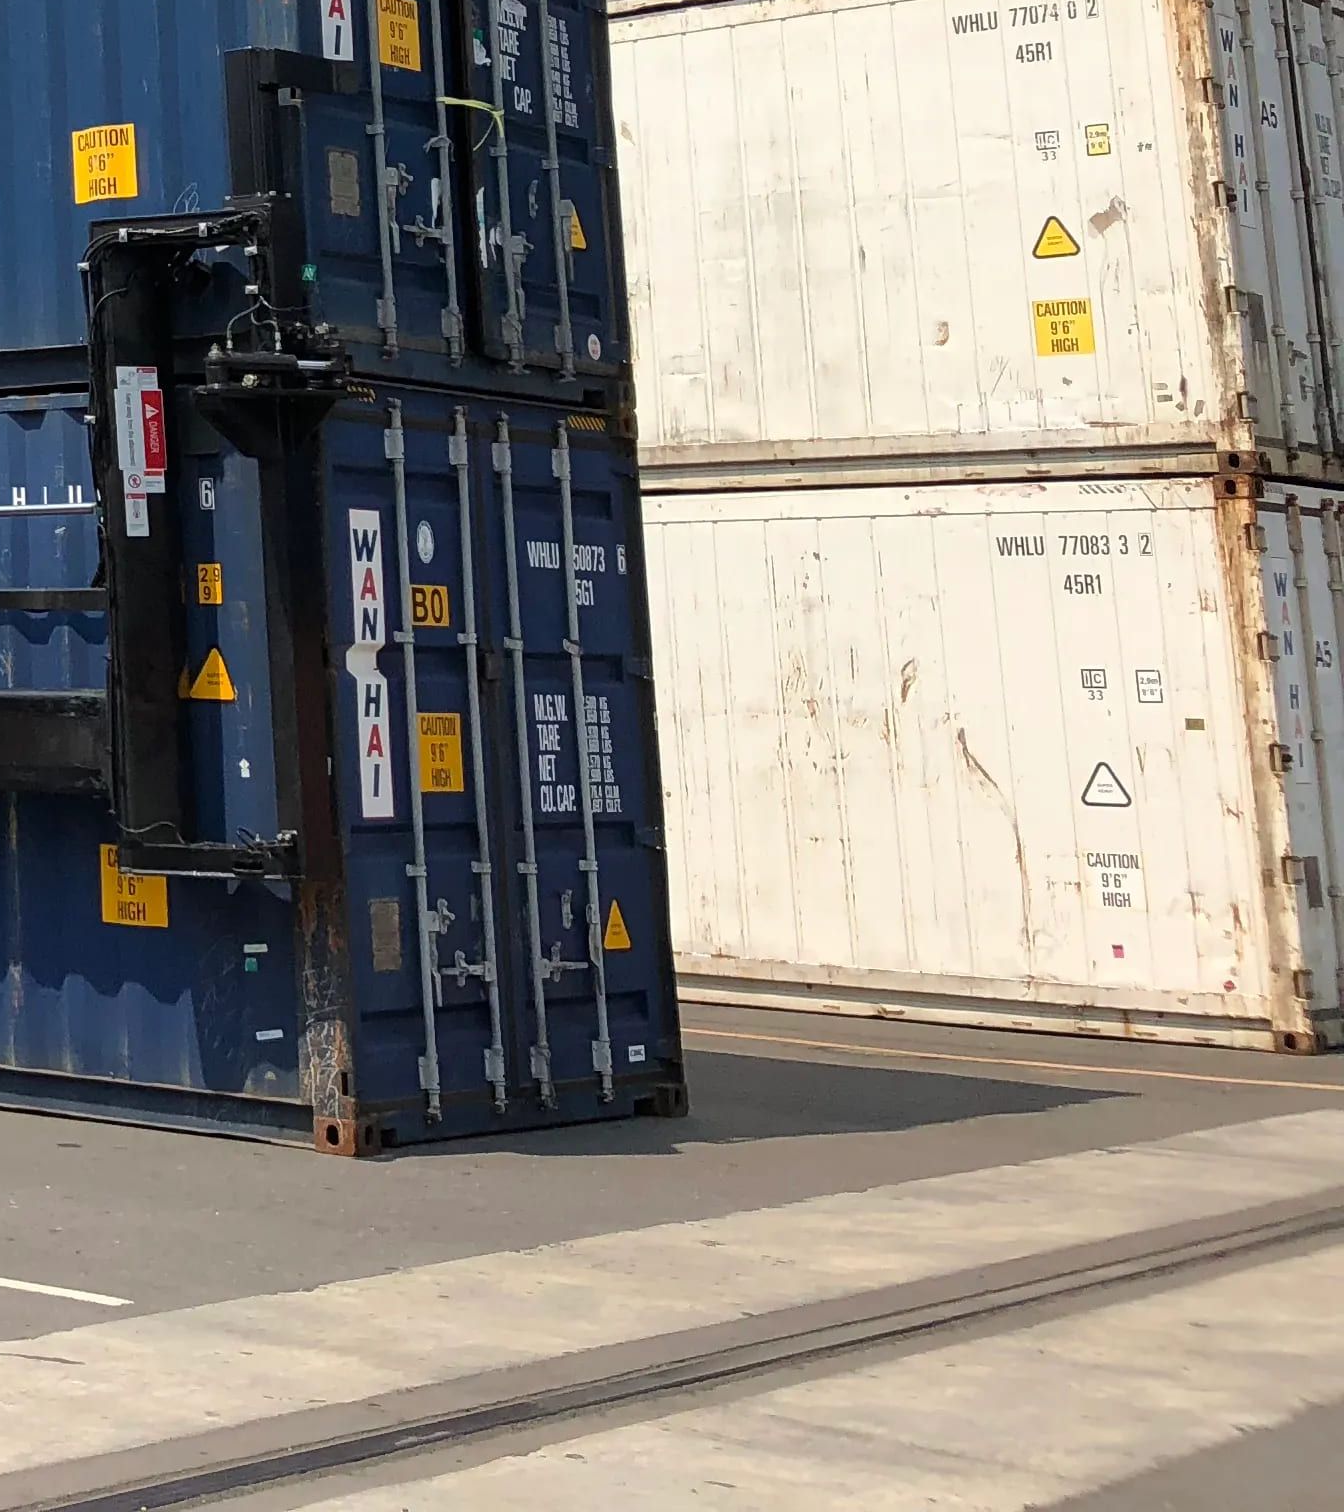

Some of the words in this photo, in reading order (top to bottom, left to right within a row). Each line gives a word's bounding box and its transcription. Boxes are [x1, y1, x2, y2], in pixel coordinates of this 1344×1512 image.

[952, 11, 999, 36] WHLU
[1009, 2, 1060, 27] 77074
[389, 41, 411, 66] HIGH
[498, 26, 521, 57] TARE
[1015, 41, 1053, 64] 45R1
[1219, 27, 1239, 108] WAN
[1234, 133, 1249, 213] HAI
[1260, 101, 1278, 129] A5
[77, 127, 130, 153] CAUTION
[1041, 151, 1057, 162] 33
[88, 177, 118, 198] HIGH
[1036, 300, 1087, 318] CAUTION
[1050, 319, 1076, 336] 9'6"
[1050, 337, 1079, 353] HIGH
[148, 421, 160, 454] DANGER
[202, 480, 213, 507] 6
[526, 540, 560, 571] WHLU
[616, 547, 626, 571] 6
[996, 535, 1045, 557] WHLU
[1057, 534, 1110, 556] 77083
[1118, 535, 1129, 555] 3
[1140, 534, 1150, 555] 2
[351, 527, 379, 642] WAN
[1063, 574, 1103, 595] 45R1
[1273, 571, 1294, 656] WAN
[1288, 684, 1304, 768] HAI
[534, 693, 568, 722] M.G.W.
[1087, 690, 1104, 701] 33
[420, 715, 456, 737] CAUTION
[536, 724, 561, 751] TARE
[363, 683, 384, 798] HAI
[431, 767, 451, 787] HIGH
[538, 754, 556, 782] NET
[1087, 852, 1139, 870] CAUTION
[1101, 872, 1128, 889] 9'6"
[117, 901, 147, 922] HIGH
[1102, 891, 1132, 908] HIGH
